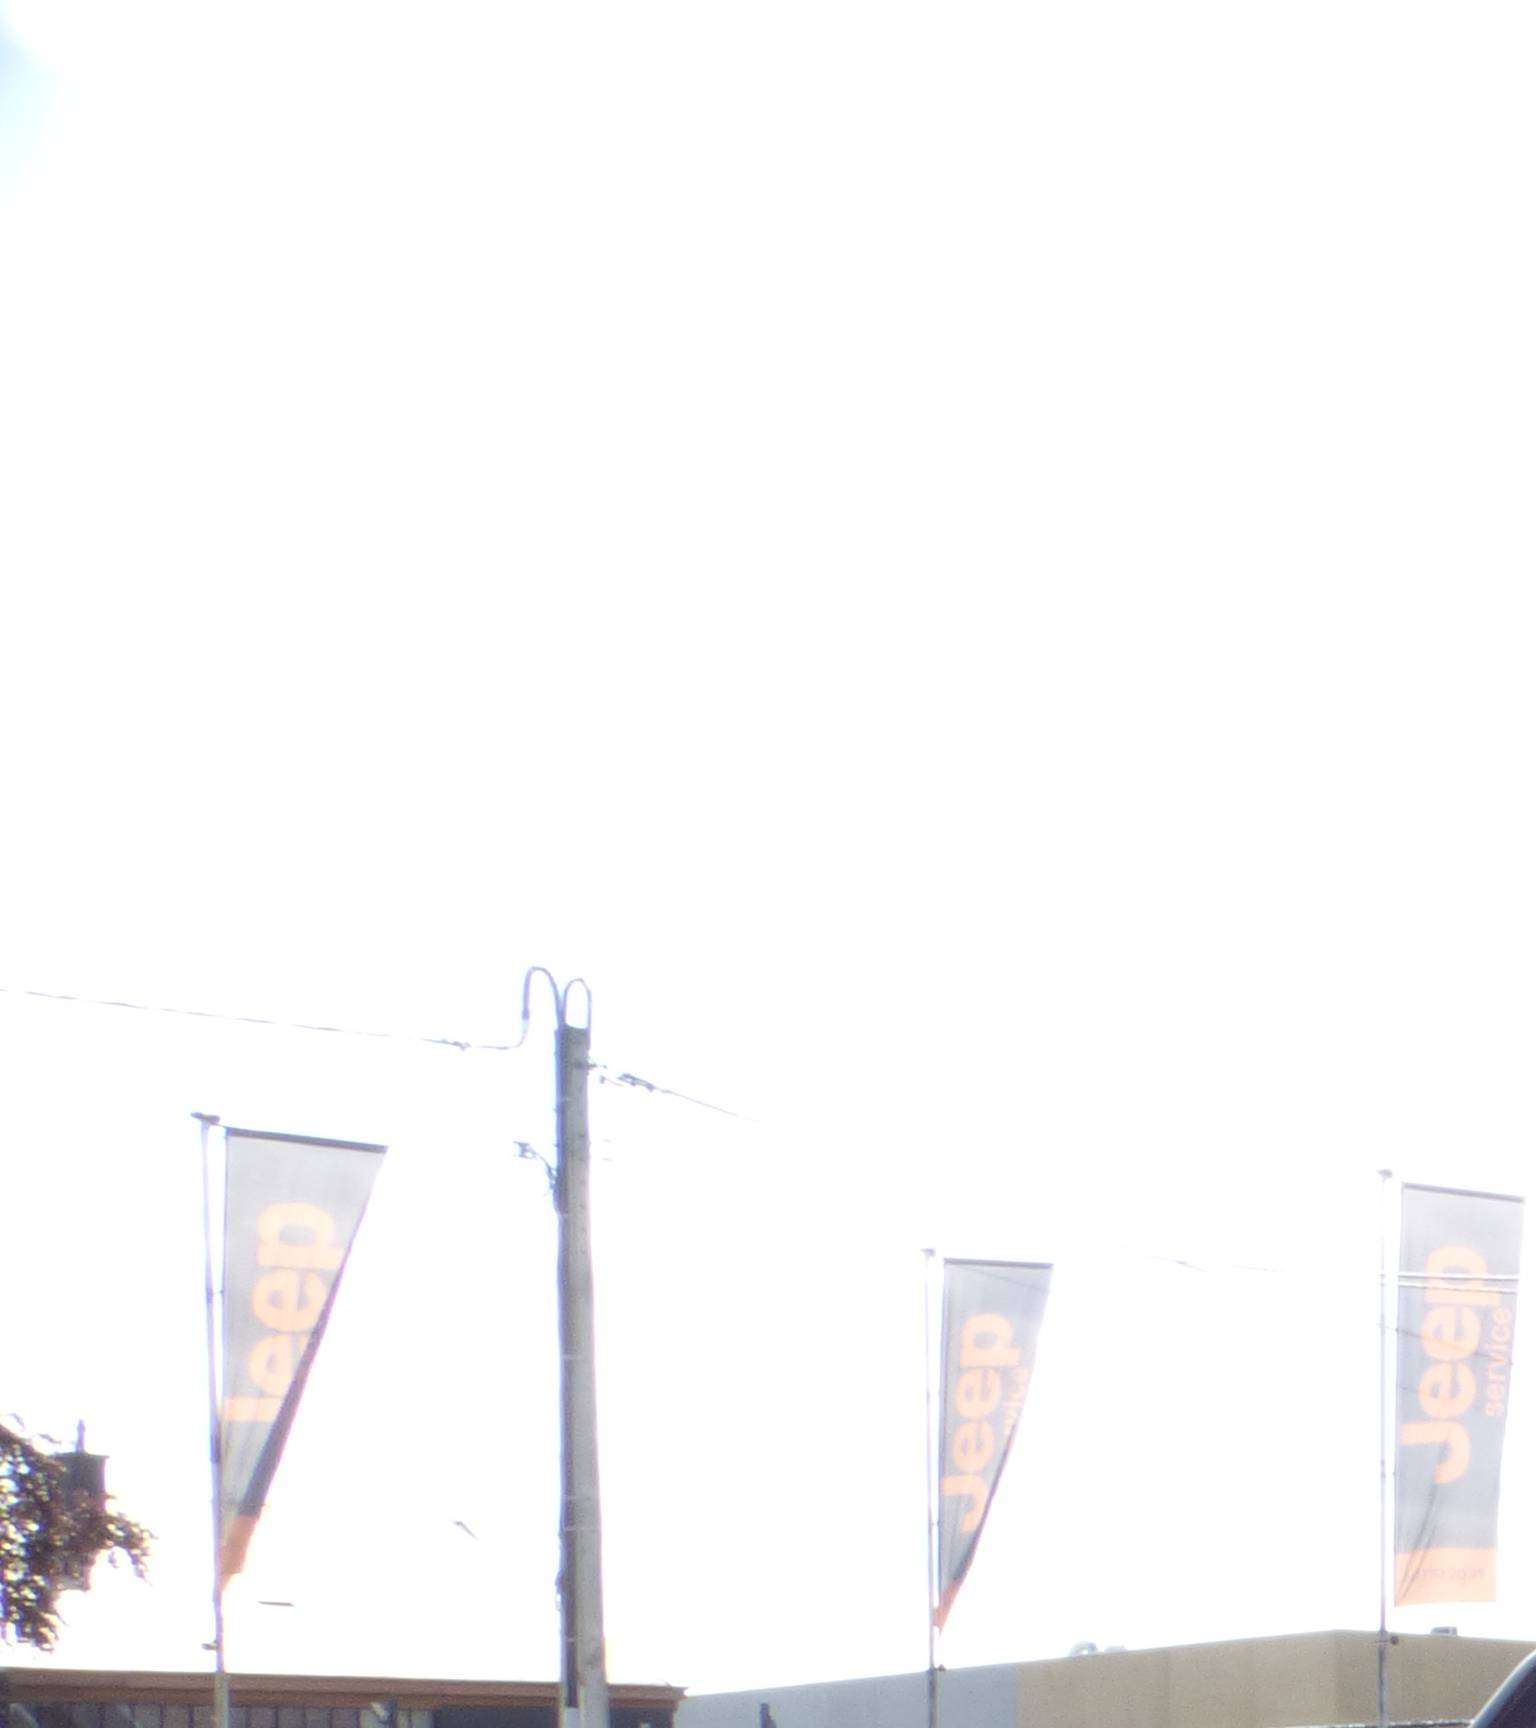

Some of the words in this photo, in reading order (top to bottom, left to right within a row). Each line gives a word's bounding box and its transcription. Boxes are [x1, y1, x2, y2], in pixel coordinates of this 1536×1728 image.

[940, 1312, 1019, 1533] Jeep
[1400, 1244, 1500, 1484] Jeep
[1482, 1305, 1514, 1418] service
